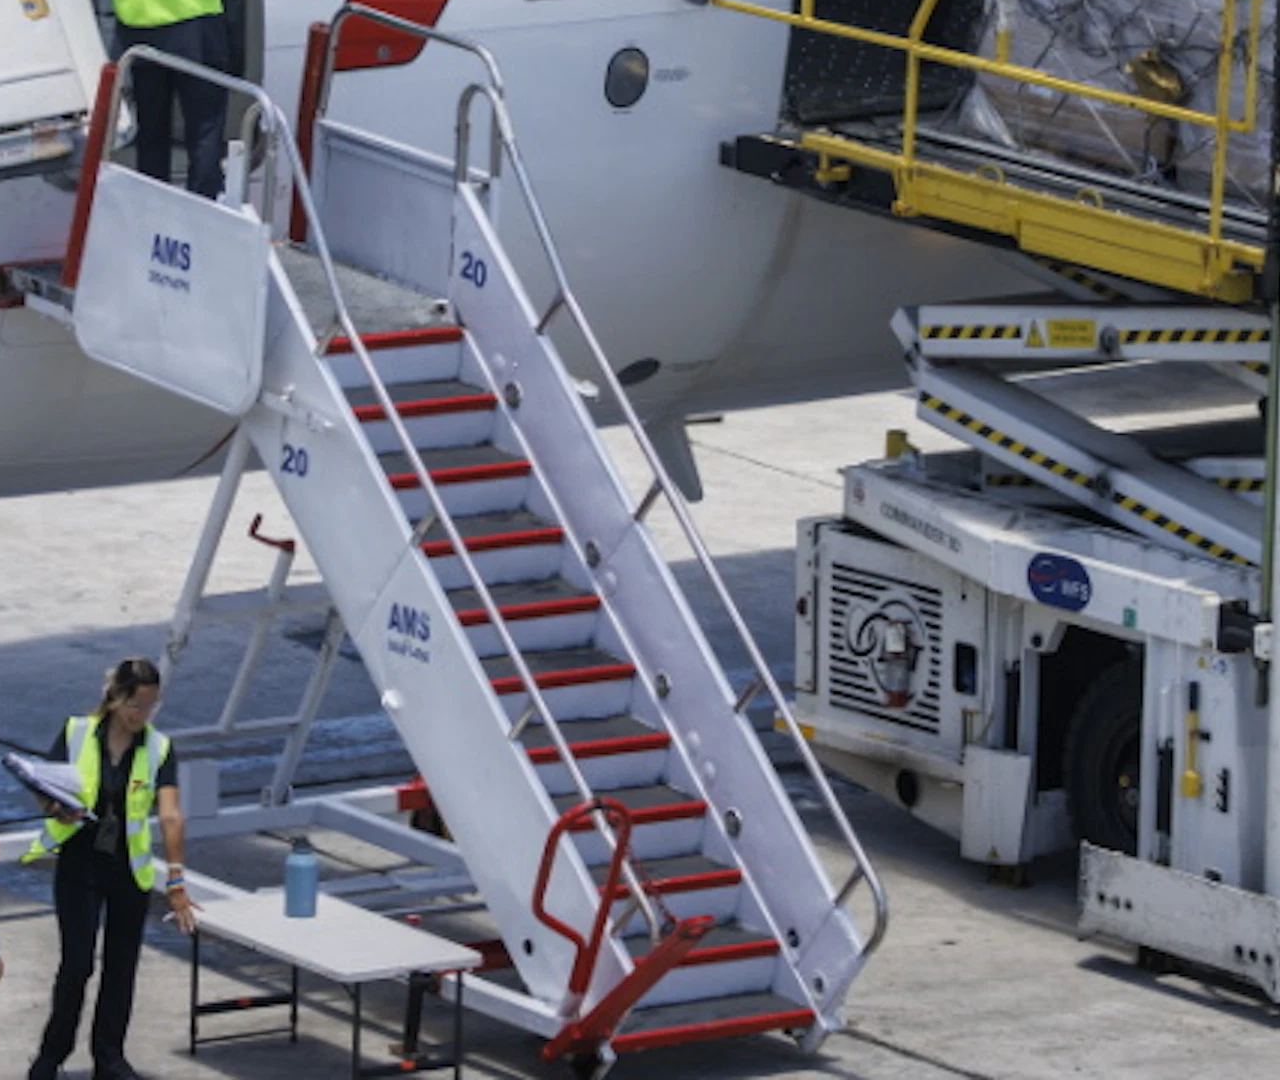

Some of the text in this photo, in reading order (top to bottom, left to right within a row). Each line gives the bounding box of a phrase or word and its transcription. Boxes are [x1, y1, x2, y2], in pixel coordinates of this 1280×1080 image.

[151, 233, 191, 271] AMS
[460, 250, 487, 289] 20
[280, 443, 308, 478] 20
[388, 602, 430, 642] AMS
